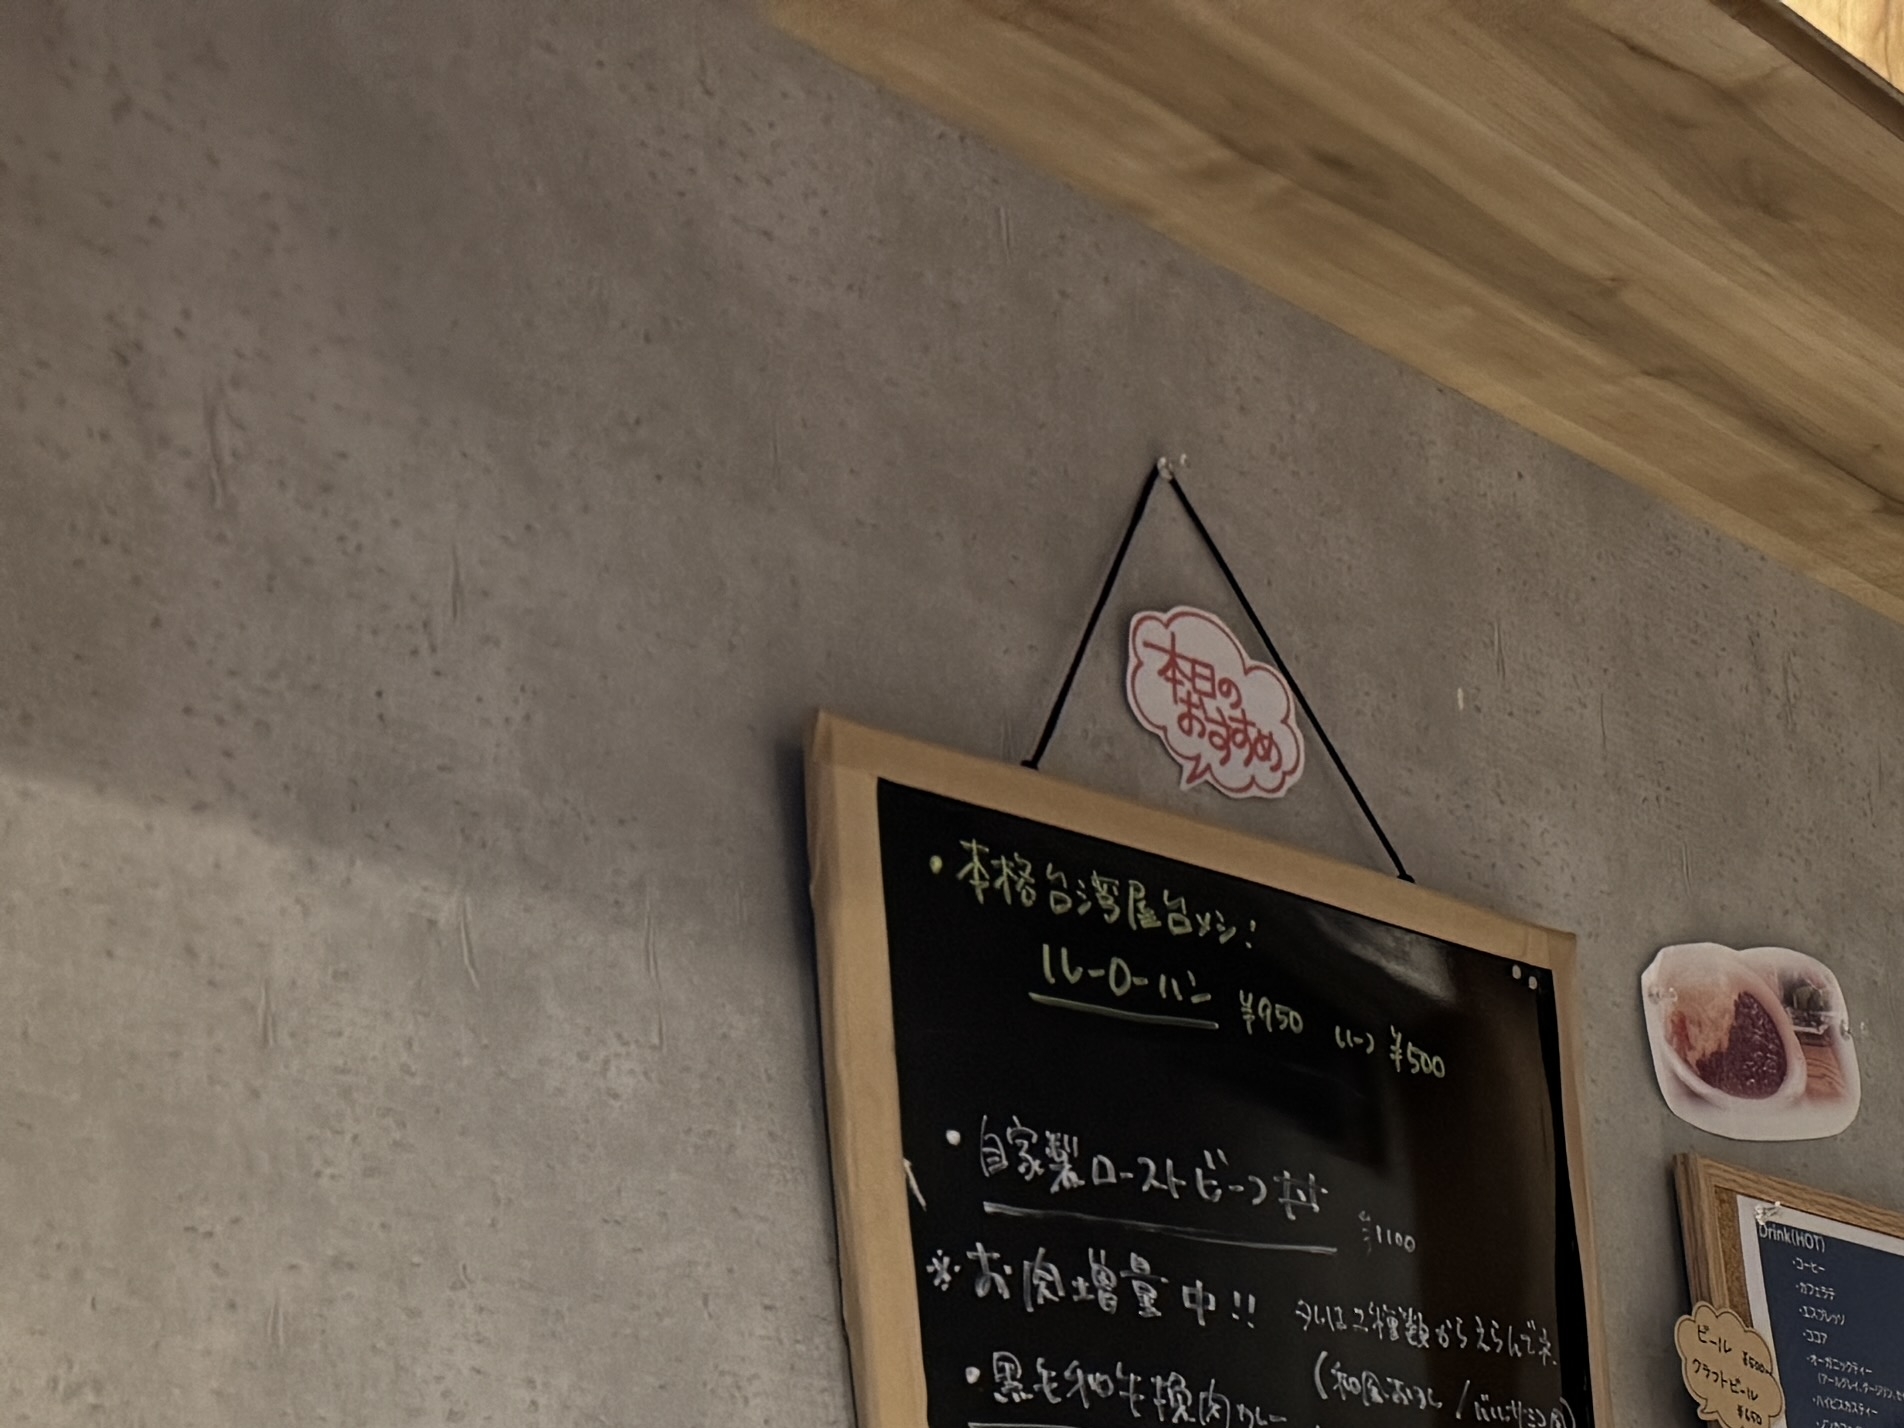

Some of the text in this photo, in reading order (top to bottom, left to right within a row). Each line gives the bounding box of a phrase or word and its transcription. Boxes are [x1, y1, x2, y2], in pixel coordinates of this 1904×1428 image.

[1142, 632, 1241, 709] 本日の
[1178, 690, 1283, 772] おすすめ
[1697, 1324, 1733, 1355] ビール
[1692, 1358, 1759, 1402] クラフトビール
